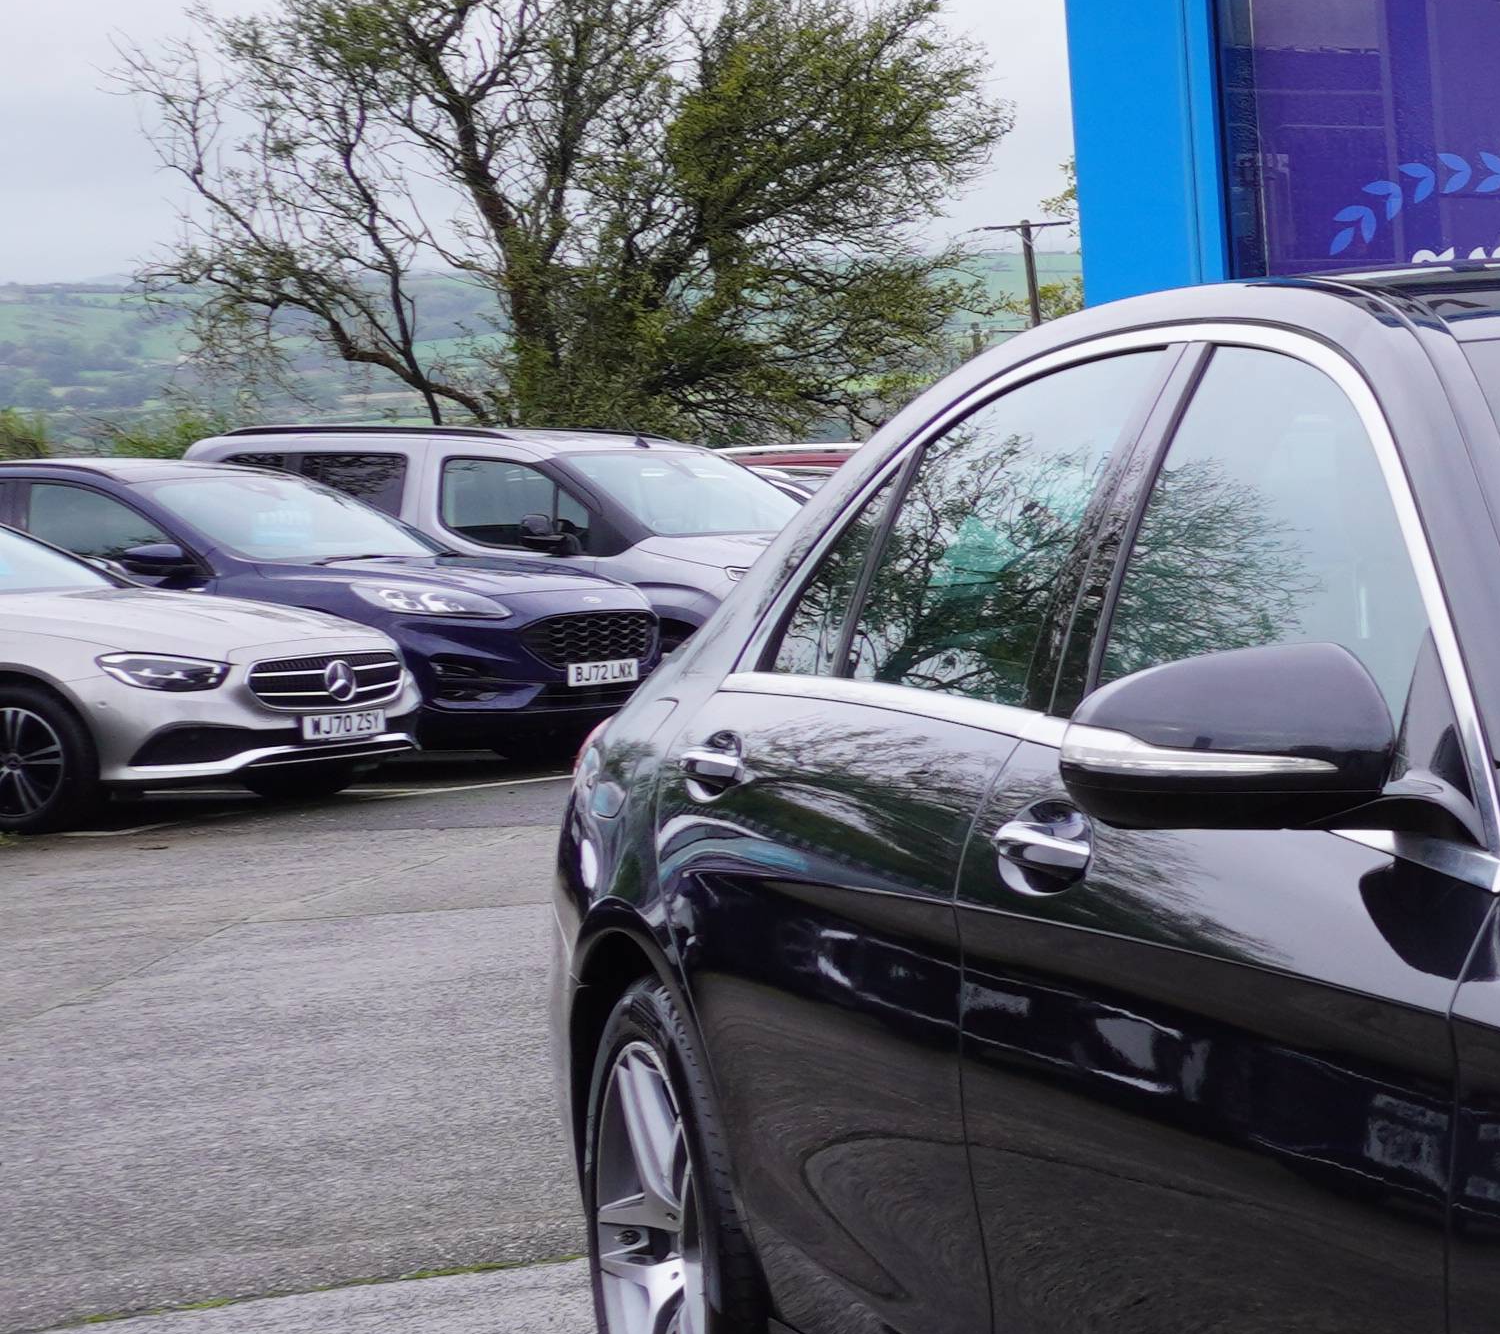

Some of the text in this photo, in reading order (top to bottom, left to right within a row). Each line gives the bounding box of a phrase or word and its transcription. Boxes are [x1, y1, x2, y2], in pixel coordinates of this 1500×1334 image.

[575, 661, 633, 683] BJ72 LNX
[311, 711, 380, 735] WJ70 ZSY
